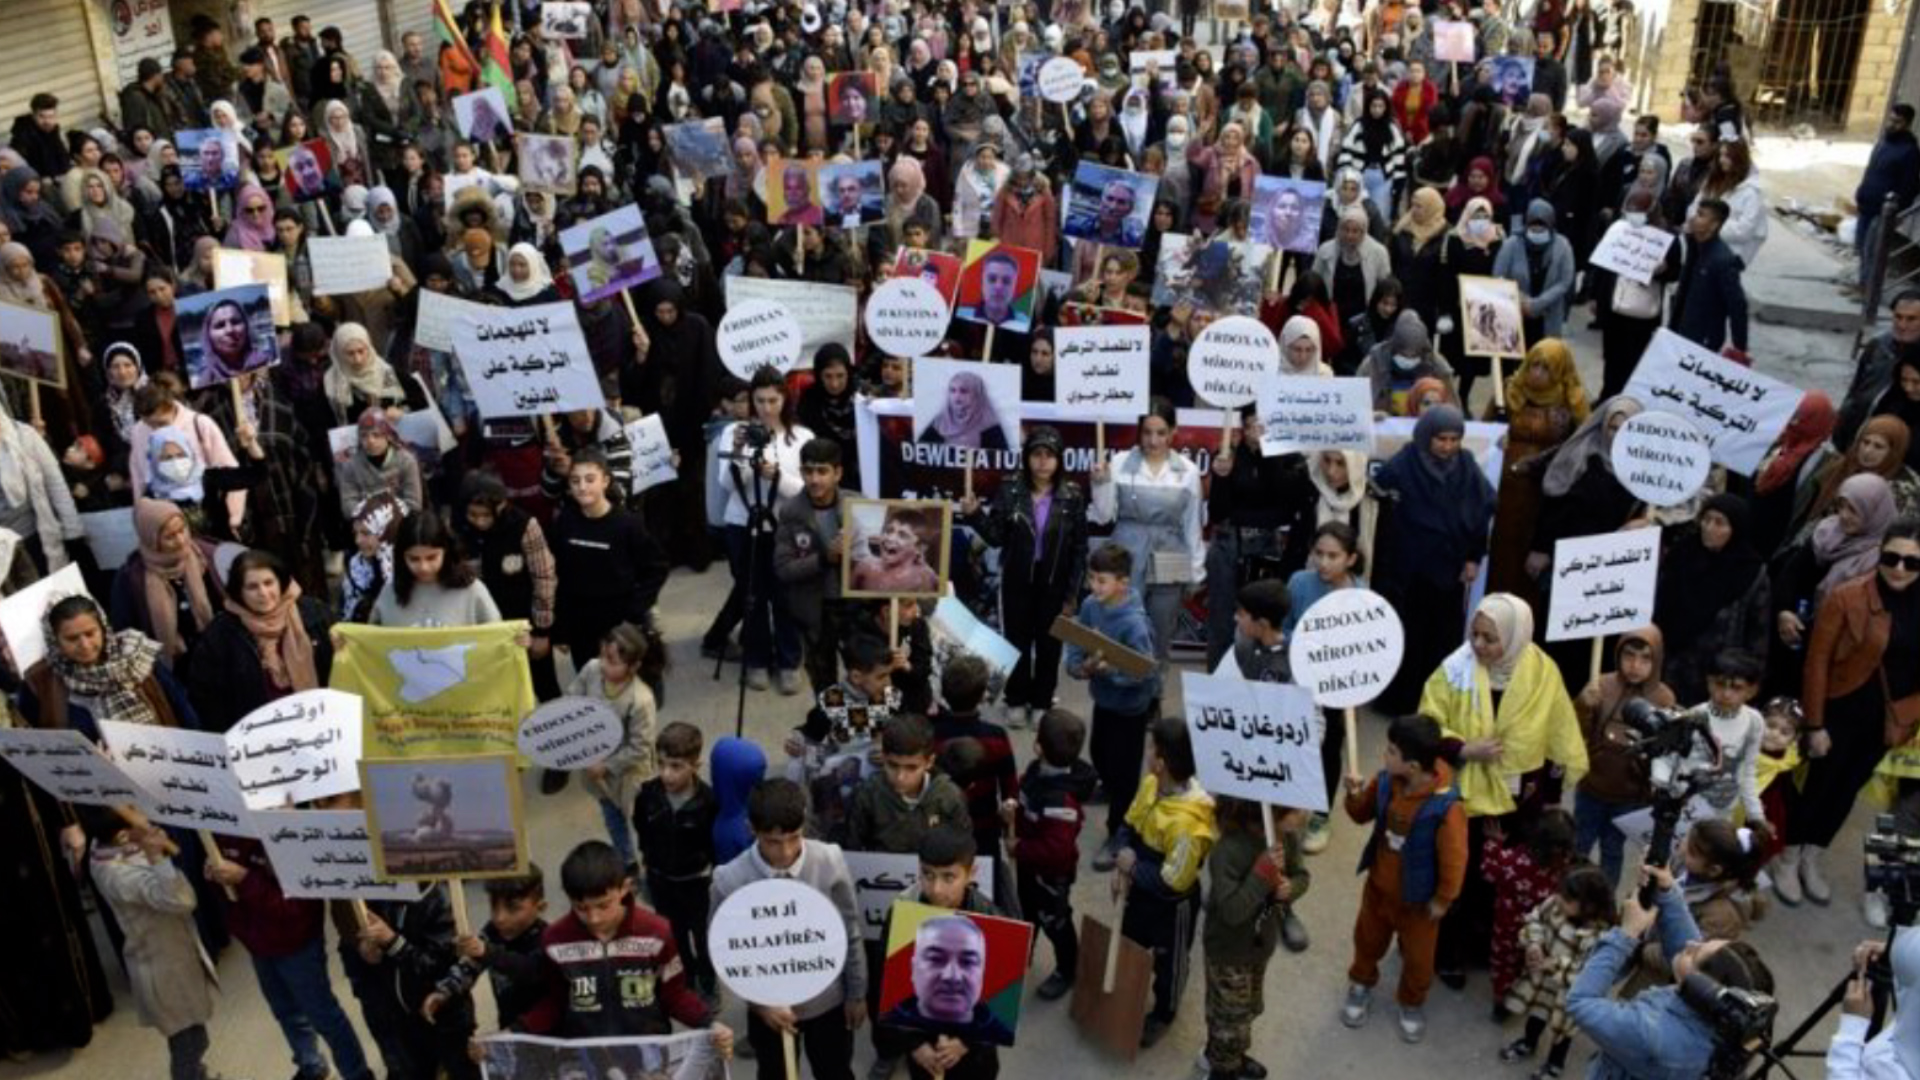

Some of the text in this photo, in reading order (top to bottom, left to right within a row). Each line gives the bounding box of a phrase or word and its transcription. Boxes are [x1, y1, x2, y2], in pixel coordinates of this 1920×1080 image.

[477, 316, 550, 344] لا للهجمات
[482, 351, 570, 380] التركية على
[1678, 354, 1768, 402] لا للهجمات
[1651, 383, 1758, 434] التركية على
[1626, 420, 1699, 443] ERDOXAN
[901, 442, 989, 470] DEWLEA
[1604, 549, 1642, 566] للقصف
[1643, 547, 1652, 561] لا
[1583, 578, 1625, 601] نطالب
[1302, 606, 1388, 633] ERDOXAN
[1600, 606, 1638, 626] بحظر
[522, 703, 597, 739] ERDOXAN
[1195, 705, 1311, 746] أردوغان قاتل
[215, 753, 228, 770] لا
[1221, 749, 1294, 788] البشرية
[311, 851, 369, 867] نطالب
[751, 905, 778, 919] EM
[725, 964, 753, 979] WE
